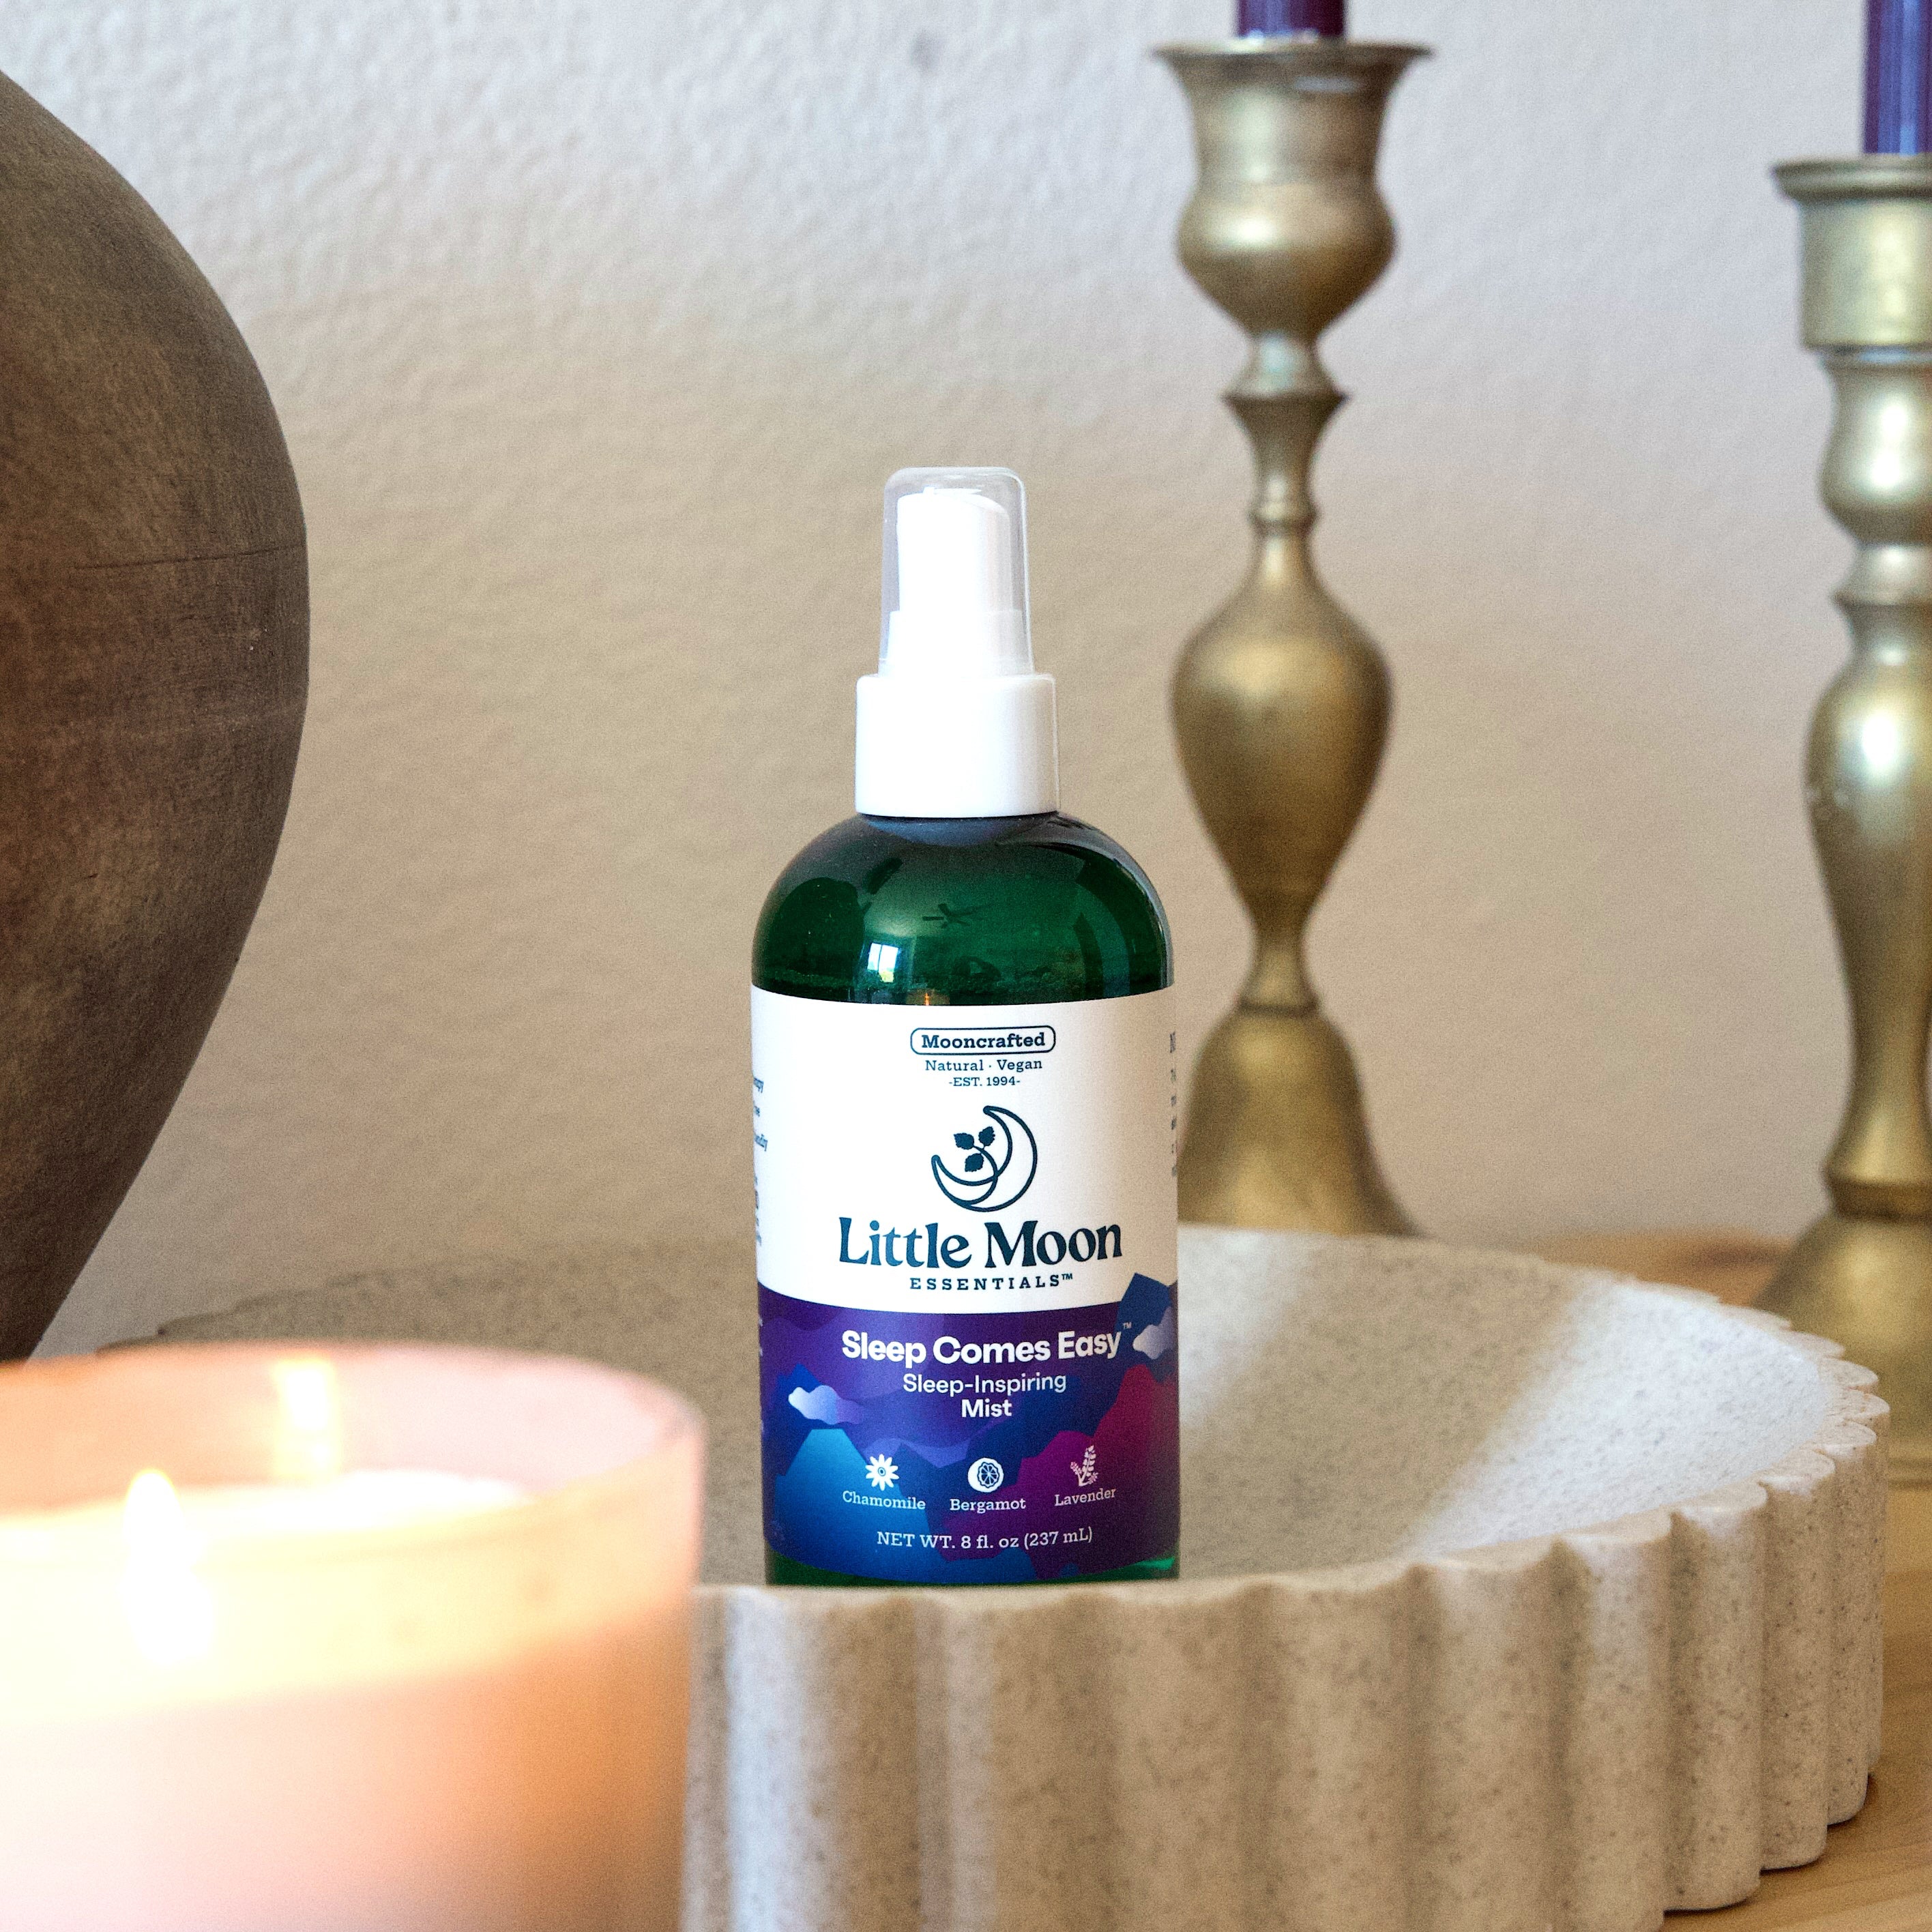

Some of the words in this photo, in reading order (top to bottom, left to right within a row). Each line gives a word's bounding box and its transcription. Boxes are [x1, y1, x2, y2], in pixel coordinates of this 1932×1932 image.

[921, 1031, 1046, 1049] Mooncrafted
[925, 1059, 984, 1072] Natural
[997, 1059, 1043, 1073] Vegan
[838, 1217, 972, 1269] Little
[984, 1220, 1123, 1269] Moon
[842, 1330, 926, 1369] Sleep
[933, 1336, 1051, 1364] Comes
[903, 1372, 1067, 1396] Sleep-Inspiring
[961, 1398, 1012, 1418] Mist
[842, 1490, 926, 1511] Chamomile
[950, 1498, 1027, 1514] Bergamot
[1055, 1487, 1117, 1507] Lavender
[877, 1530, 916, 1547] NET
[921, 1534, 955, 1549] WT.
[961, 1535, 971, 1549] 8
[977, 1534, 995, 1549] fl.
[999, 1538, 1019, 1549] oz
[1024, 1531, 1058, 1549] (237
[1063, 1526, 1093, 1545] mL)
